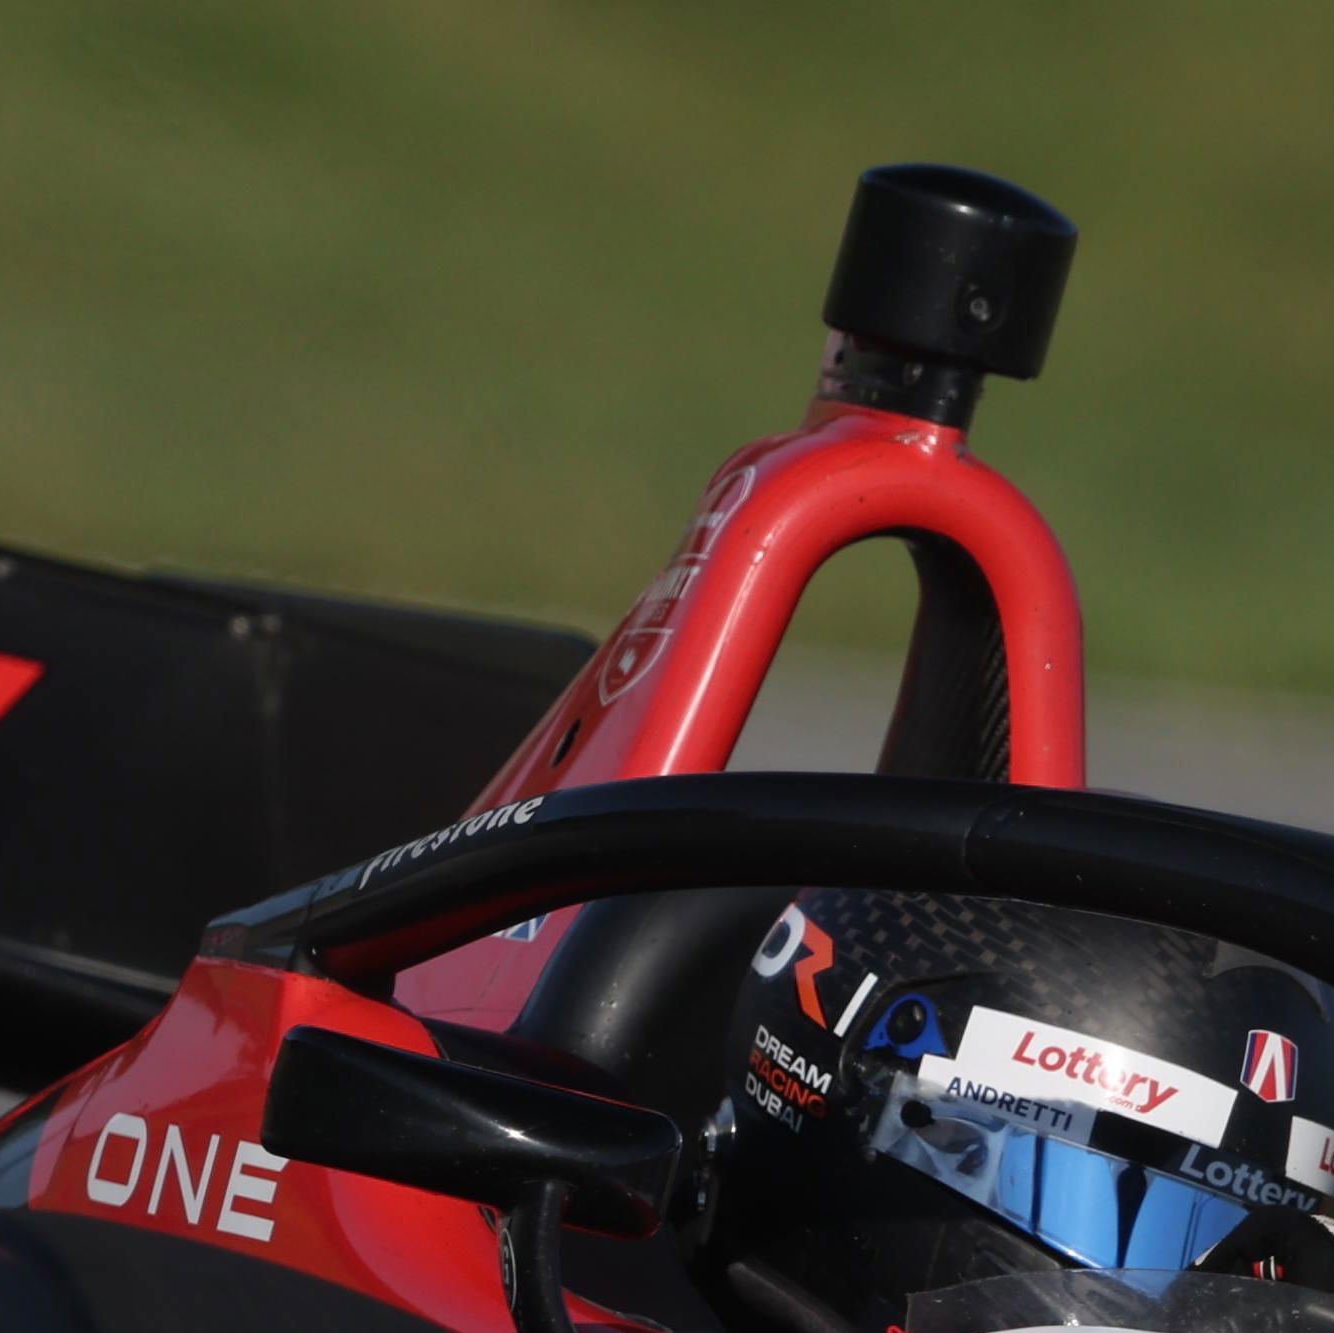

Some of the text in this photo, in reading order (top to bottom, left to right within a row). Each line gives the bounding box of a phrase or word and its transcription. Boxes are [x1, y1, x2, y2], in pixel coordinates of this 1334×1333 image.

[750, 1049, 828, 1118] RACING
[754, 1024, 833, 1094] DREAM
[745, 1072, 803, 1133] DUBAI
[947, 1076, 1073, 1132] ANDRETTI
[86, 1112, 290, 1242] ONE
